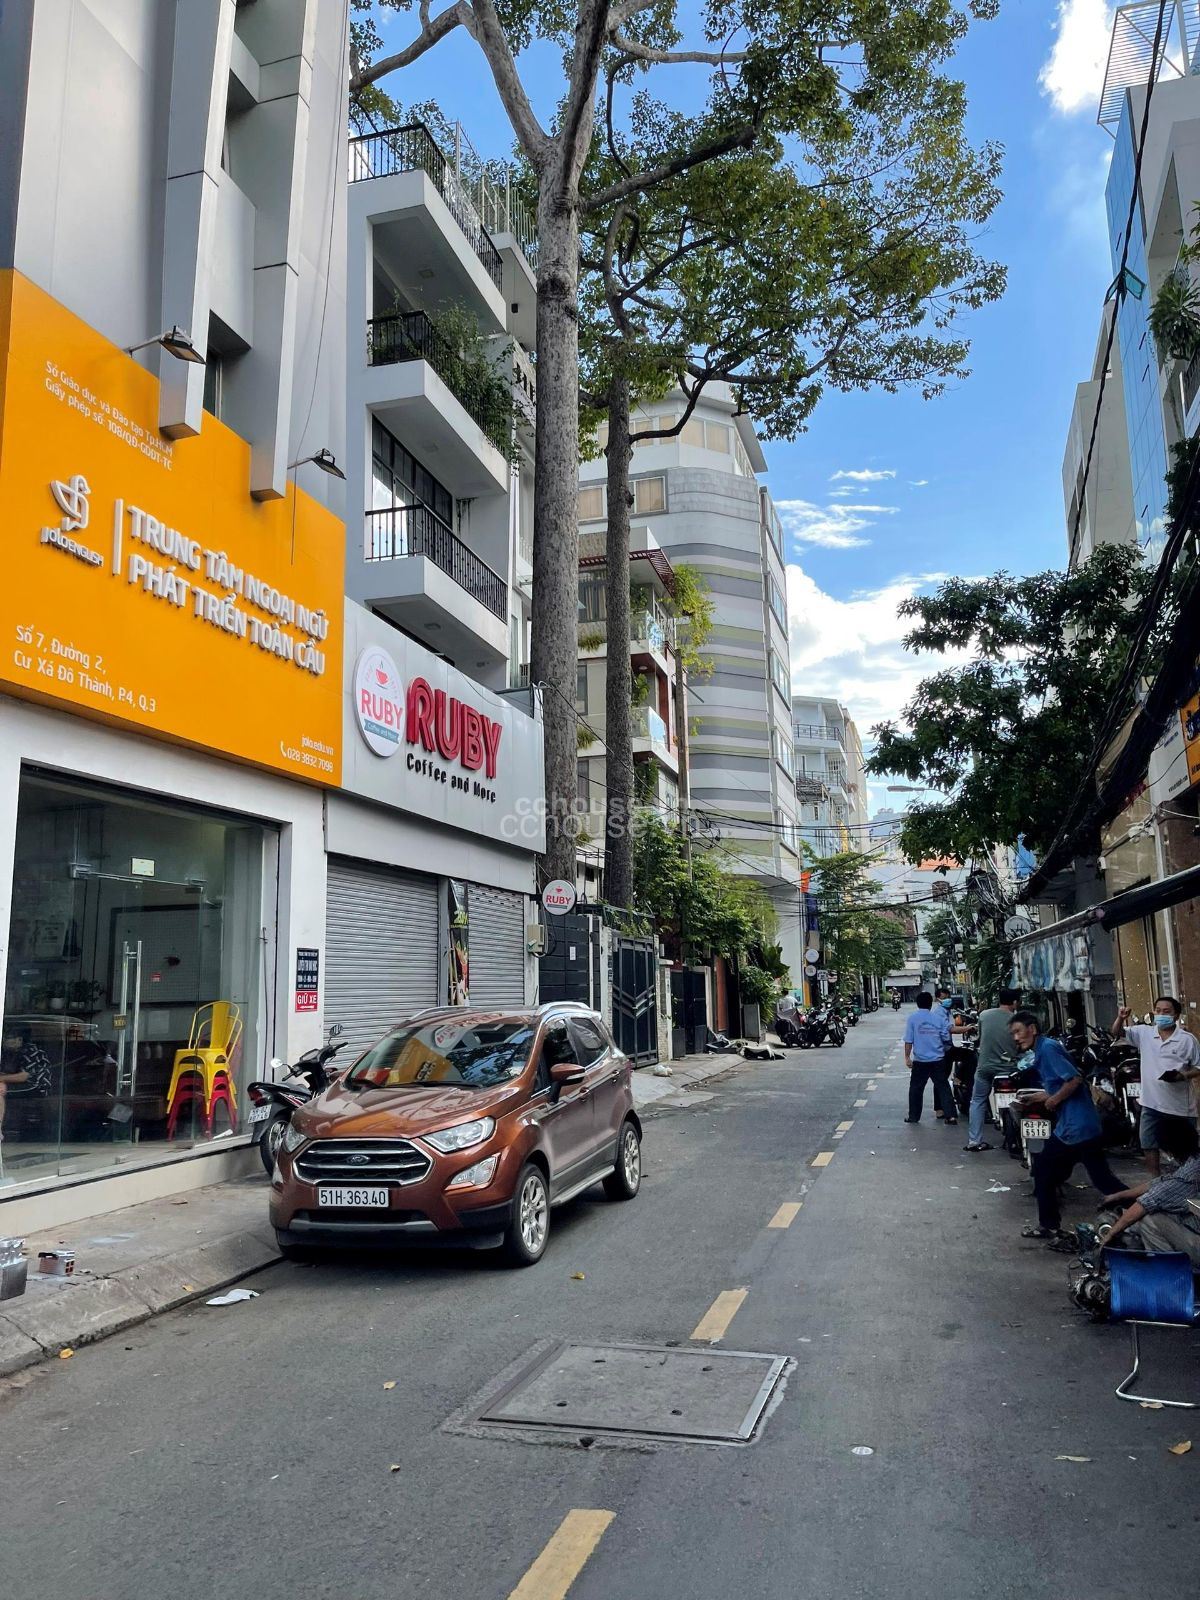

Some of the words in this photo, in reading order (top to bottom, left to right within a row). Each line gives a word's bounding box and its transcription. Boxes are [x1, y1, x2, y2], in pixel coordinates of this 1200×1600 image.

[60, 371, 80, 393] Giáo
[127, 505, 202, 572] TRUNG
[203, 549, 244, 595] TÂM
[244, 574, 295, 625] NGOẠI
[128, 554, 191, 609] PHÁT
[191, 586, 247, 640] TRIỂN
[247, 616, 294, 661] TOÀN
[294, 638, 326, 677] CẦU
[16, 624, 34, 644] Số
[36, 632, 47, 653] 7,
[51, 638, 90, 669] Đường
[95, 655, 106, 675] 2,
[14, 650, 32, 669] Cư
[37, 657, 54, 677] Xá
[57, 665, 74, 683] Đô
[78, 671, 115, 701] Thành,
[361, 687, 403, 731] RUBY
[406, 676, 503, 779] RUBY
[406, 752, 447, 784] Coffee
[451, 775, 470, 794] and
[473, 781, 497, 803] More
[545, 895, 571, 905] RUBY
[320, 1189, 386, 1205] 51H-363.40
